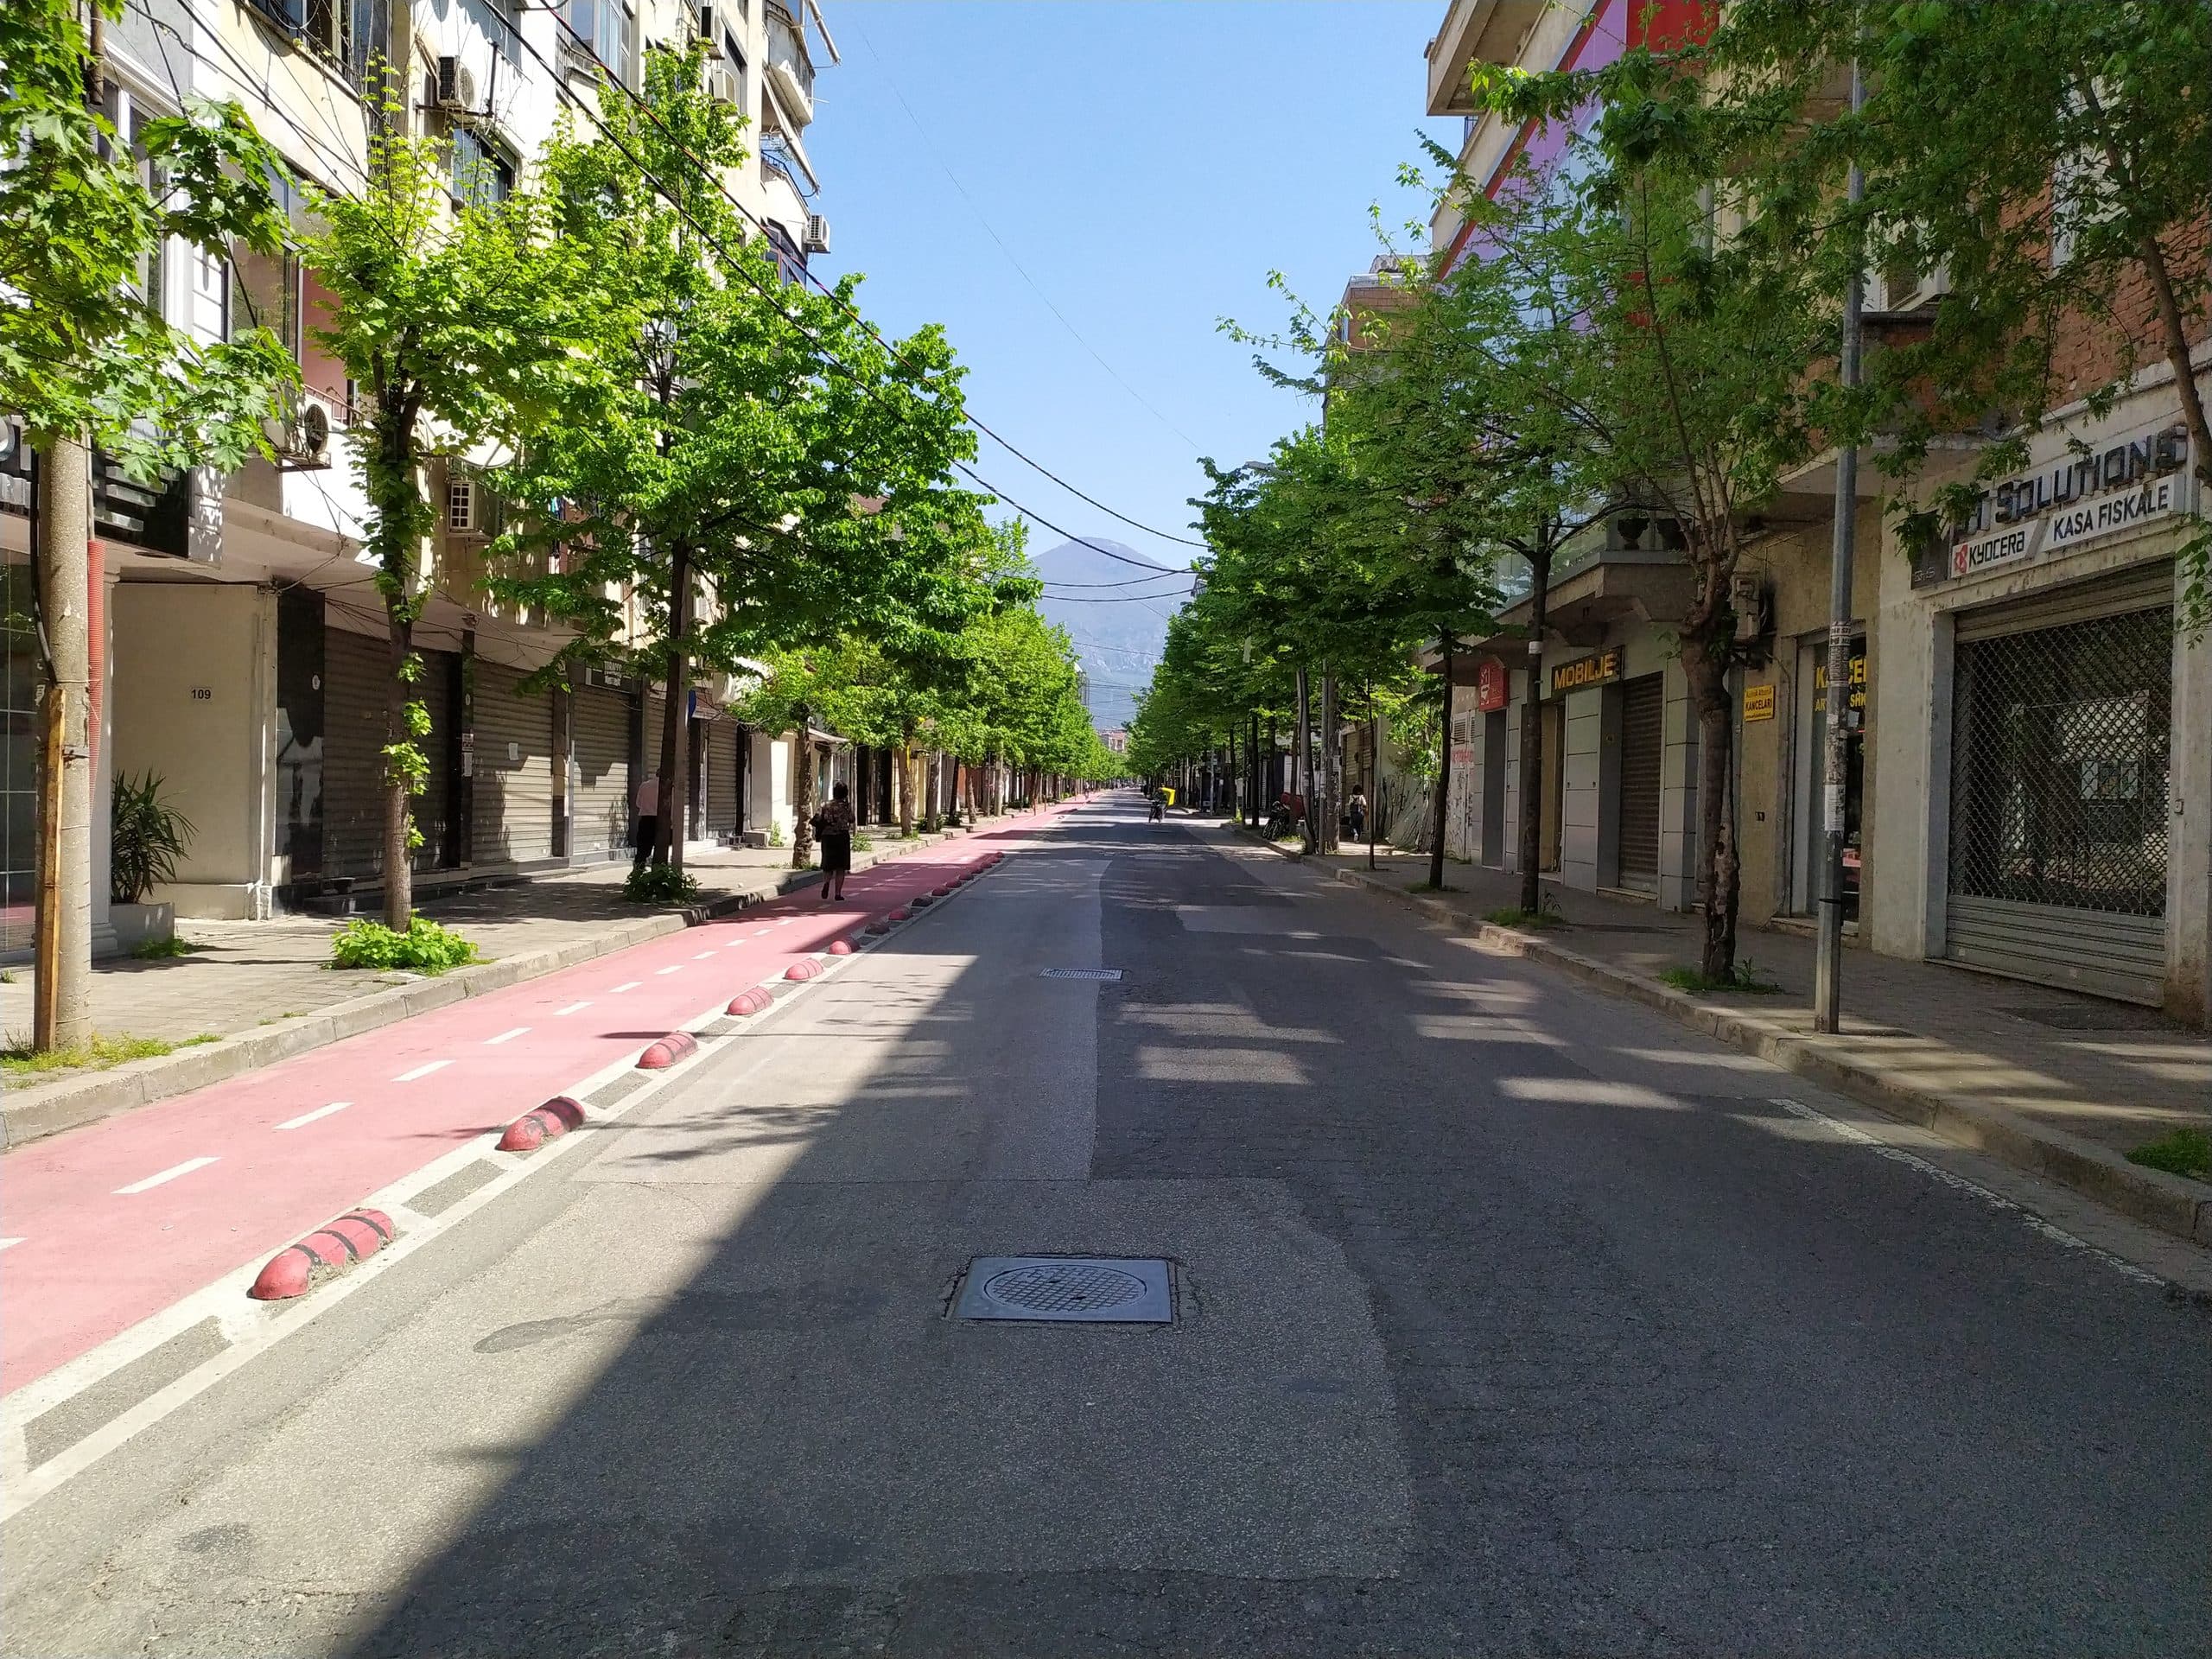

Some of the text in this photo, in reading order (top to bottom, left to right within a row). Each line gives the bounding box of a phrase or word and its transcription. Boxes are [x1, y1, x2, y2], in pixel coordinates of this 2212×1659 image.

[1995, 422, 2187, 523] SOLUTIONS
[2054, 484, 2169, 543] KASA FISKALE
[1969, 531, 2025, 567] KYOCERA
[1554, 652, 1617, 690] MOBILJE
[191, 689, 211, 700] 109
